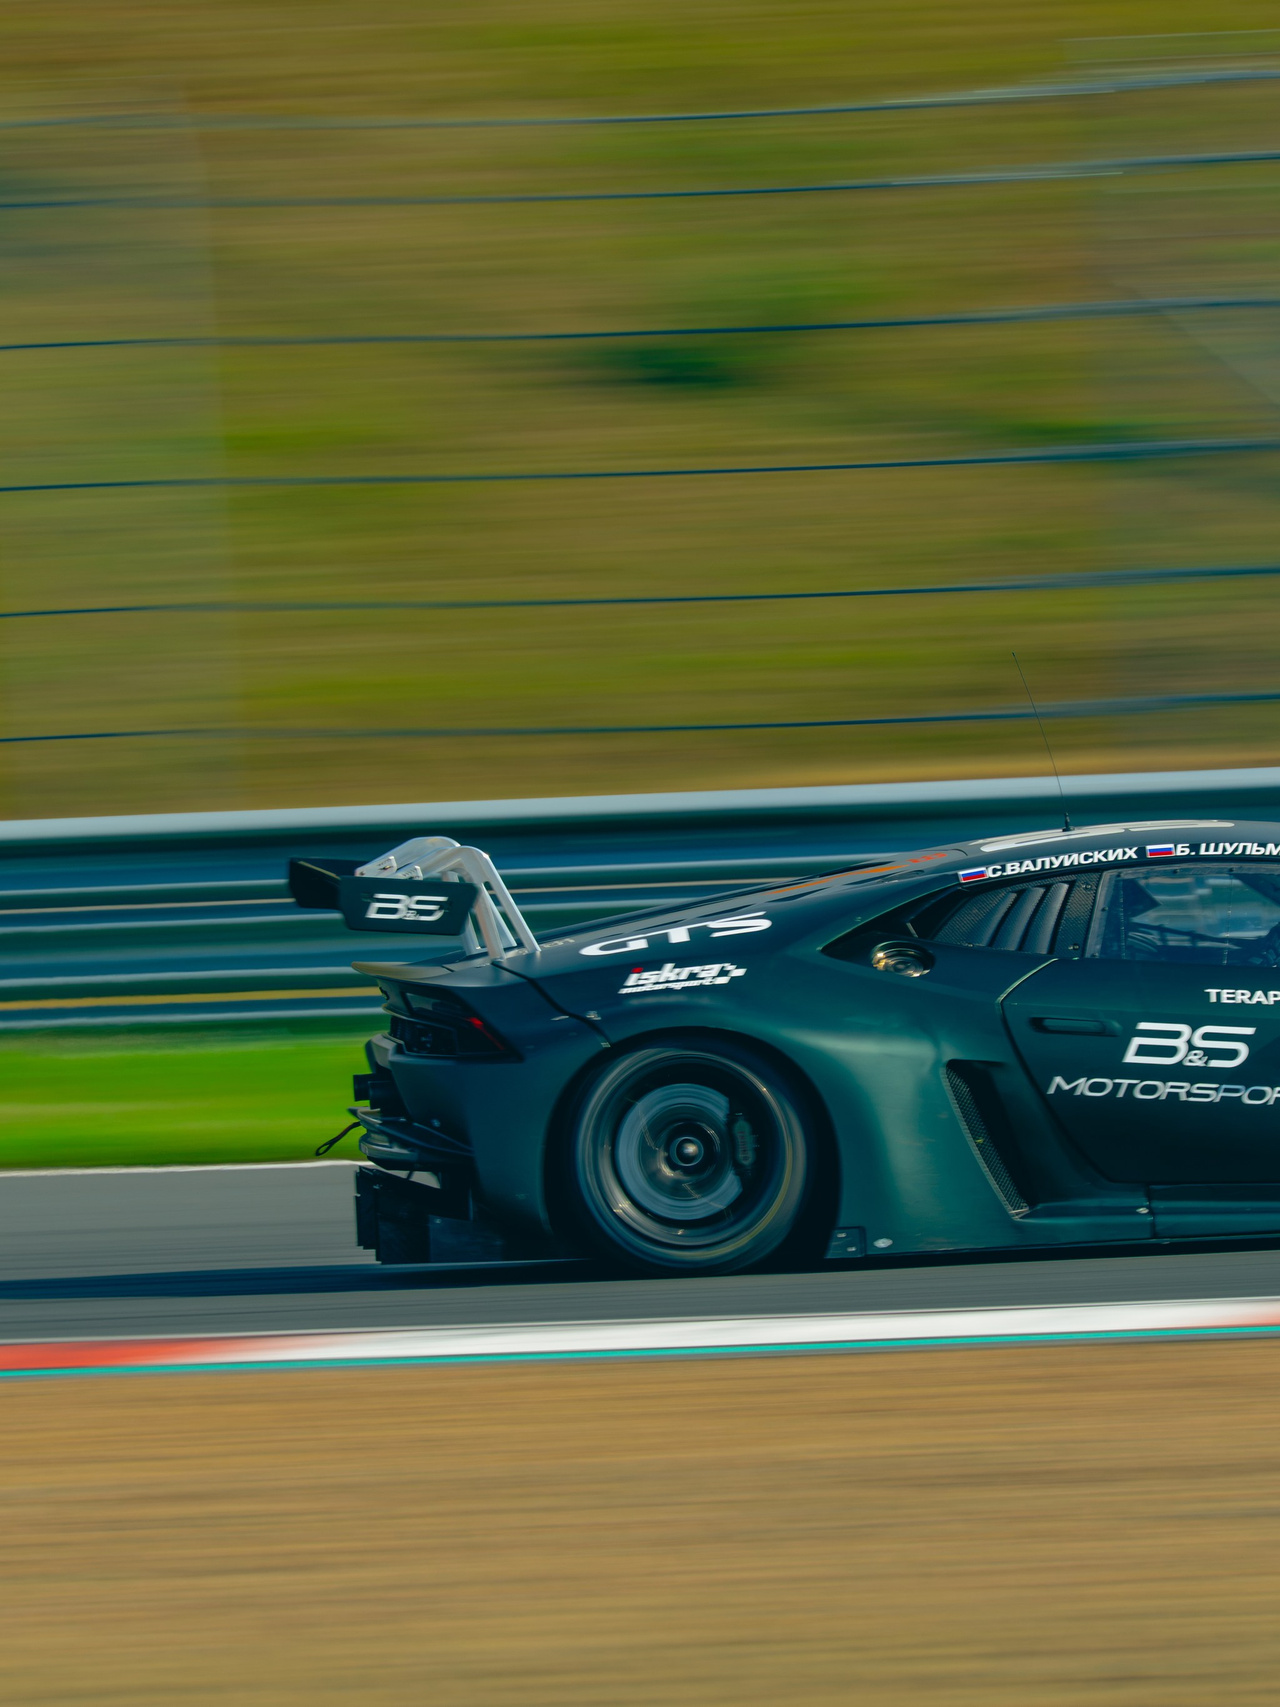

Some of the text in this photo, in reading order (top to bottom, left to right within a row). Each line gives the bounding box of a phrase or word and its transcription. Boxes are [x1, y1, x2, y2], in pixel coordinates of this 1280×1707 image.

[1175, 843, 1196, 856] Б.
[579, 911, 772, 956] GTS
[623, 962, 724, 987] iskra
[1122, 1021, 1257, 1068] B&S
